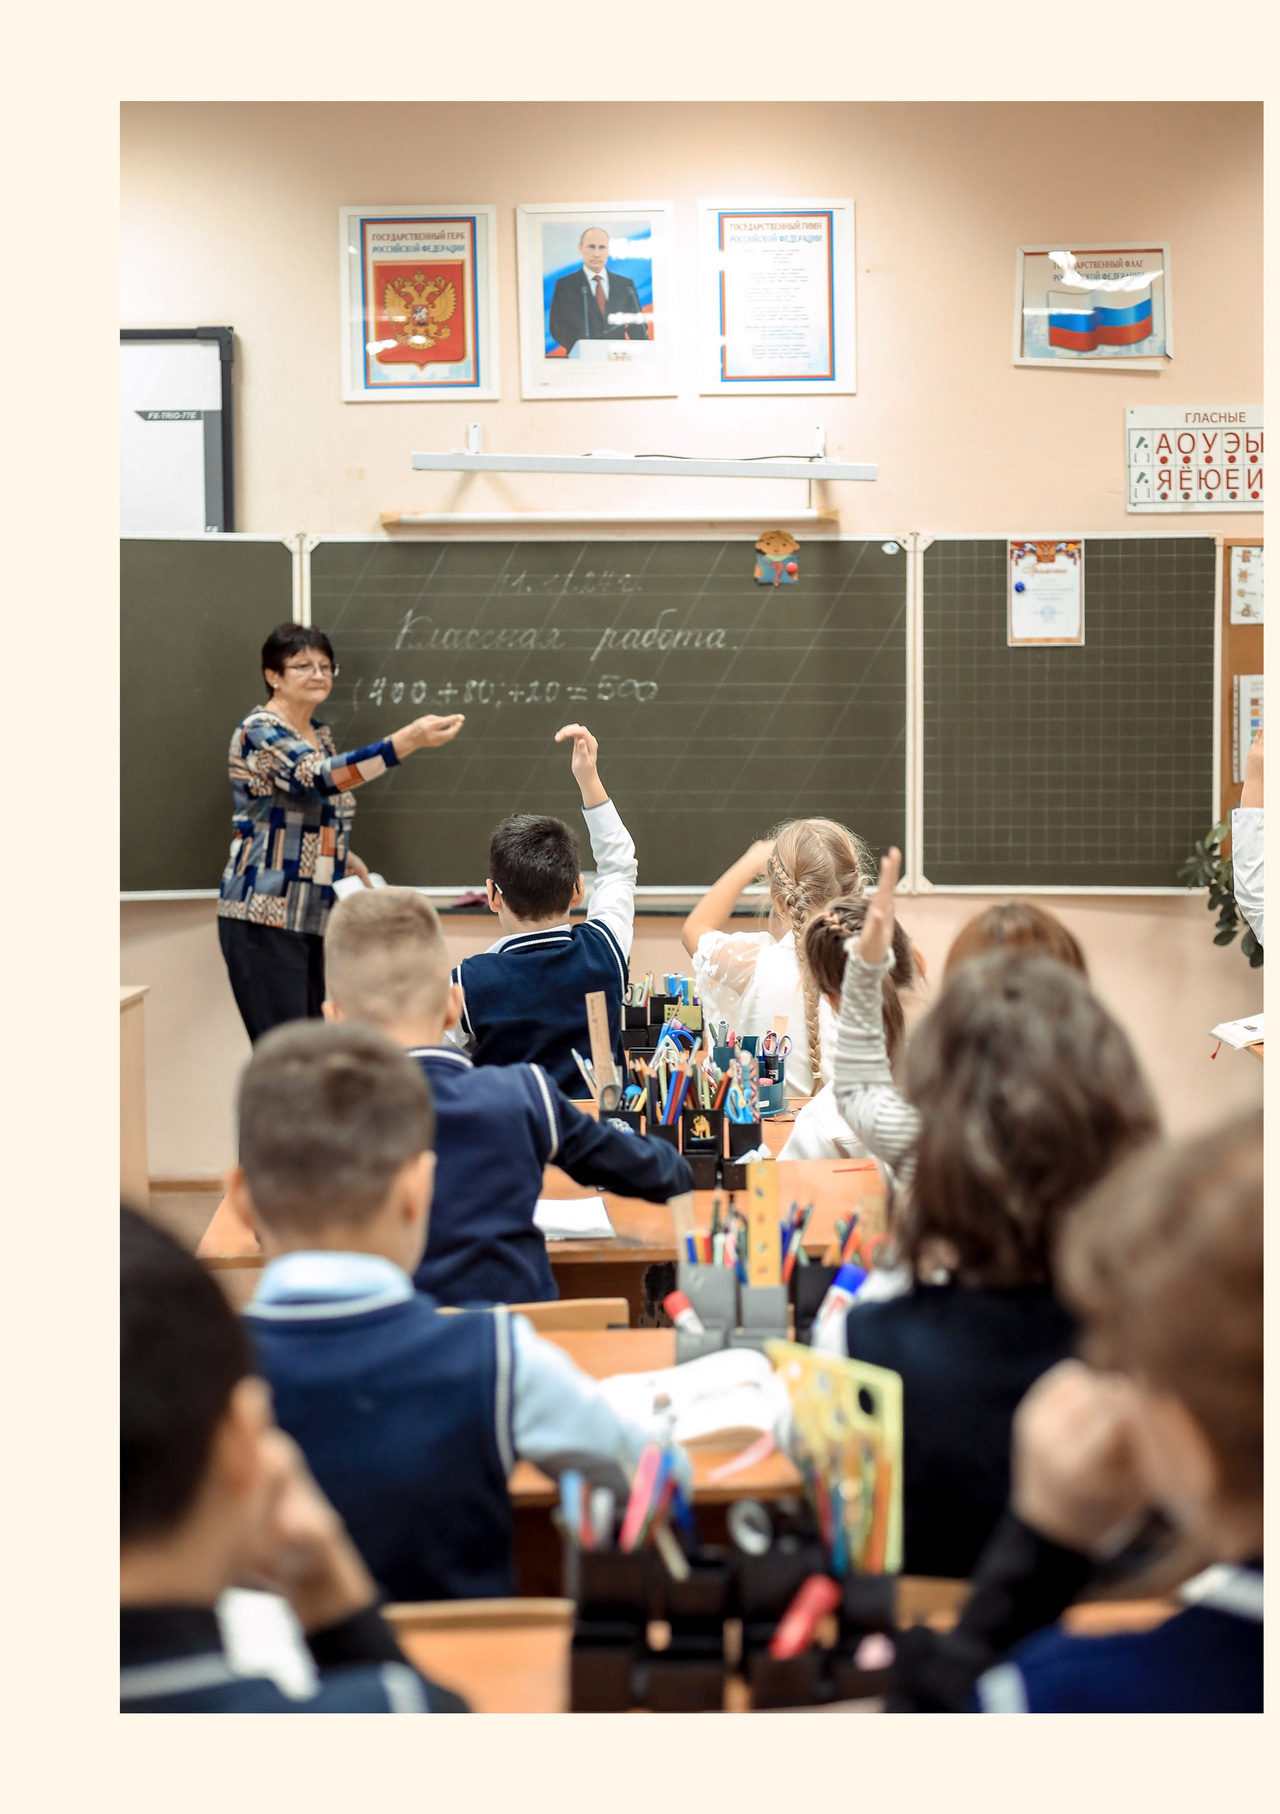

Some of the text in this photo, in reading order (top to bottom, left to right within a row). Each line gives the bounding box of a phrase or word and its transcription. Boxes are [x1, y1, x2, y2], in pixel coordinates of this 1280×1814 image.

[730, 220, 822, 231] ГОСУДАРСТВЕННЫЙ ГИМН
[372, 230, 465, 241] ГОСУДАРСТВЕННЫЙ ГЕРБ
[730, 233, 823, 244] РОССИЙСКОЙ ФЕДЕРАЦИИ
[372, 243, 465, 253] РОССИЙСКОЙ ФЕДЕРАЦИИ
[1124, 259, 1143, 268] ФЛАГ
[1185, 412, 1246, 423] ГЛАСНЫЕ
[394, 608, 566, 650] Классная
